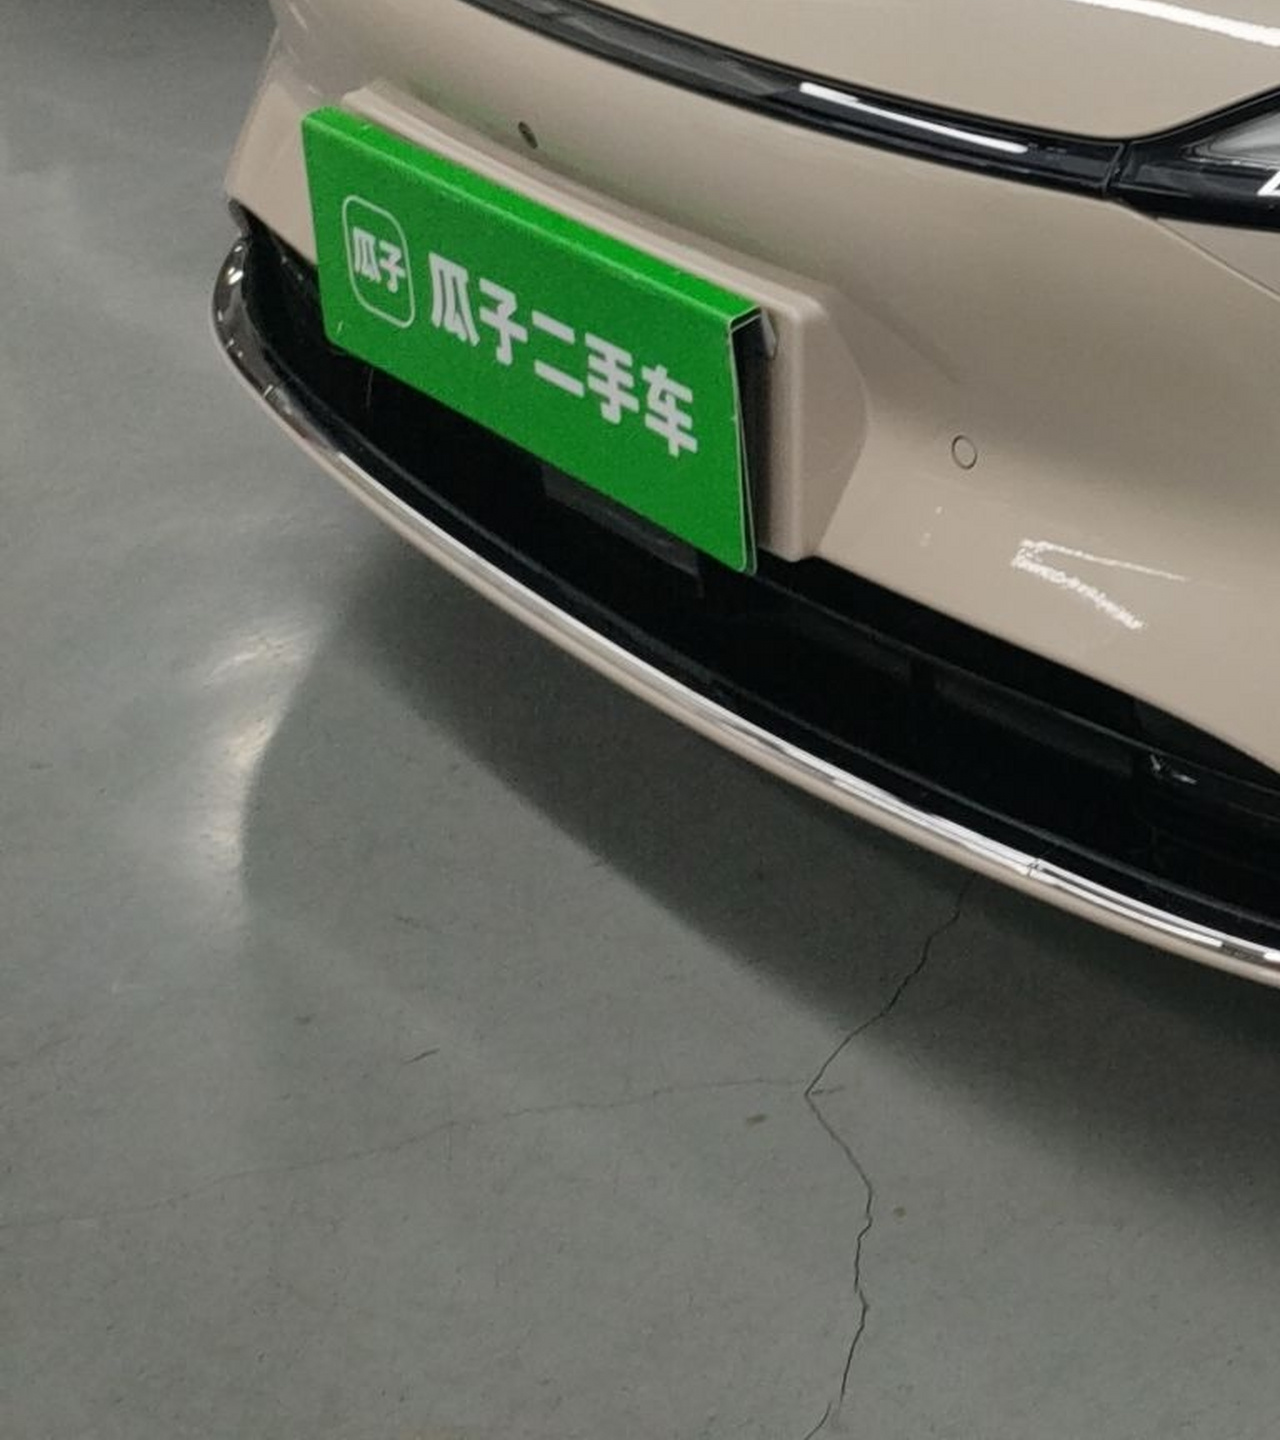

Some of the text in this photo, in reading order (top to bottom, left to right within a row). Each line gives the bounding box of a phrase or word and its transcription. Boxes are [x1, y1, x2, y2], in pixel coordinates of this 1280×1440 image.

[351, 226, 407, 294] 瓜子
[427, 251, 700, 459] 瓜子二手车
